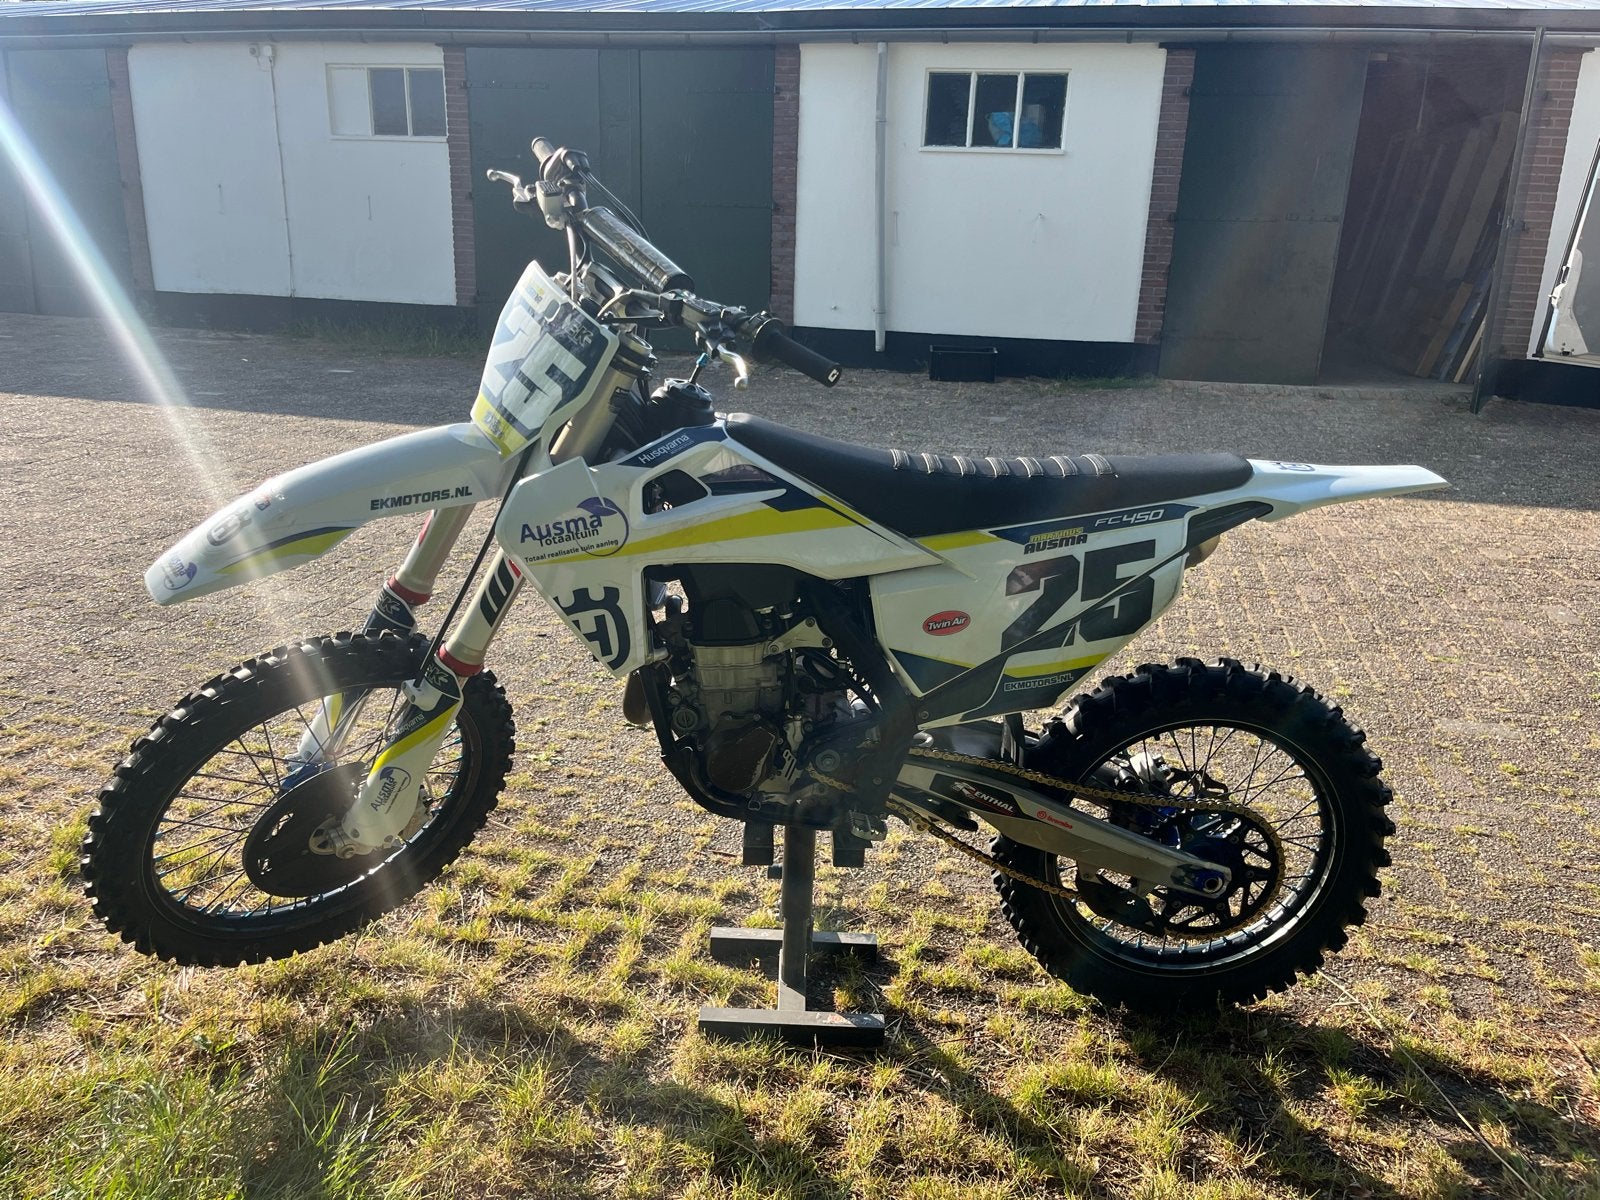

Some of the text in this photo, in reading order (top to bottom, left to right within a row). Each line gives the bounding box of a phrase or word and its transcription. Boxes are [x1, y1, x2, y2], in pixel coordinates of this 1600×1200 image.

[482, 304, 587, 430] 25
[638, 433, 690, 464] Husqvarna
[370, 486, 473, 511] EKMOTORS.NL
[520, 514, 603, 544] Ausma
[1095, 509, 1165, 527] FC450
[524, 539, 619, 563] Totaal realisatie tuin aanleg
[1023, 534, 1088, 555] AUSMA
[1001, 539, 1156, 651] 25
[928, 616, 967, 631] Twin Air
[1003, 673, 1074, 692] EKMOTORS.NL
[370, 776, 396, 812] Ausma
[952, 781, 1015, 813] RENTHAL
[1046, 815, 1074, 830] brembo
